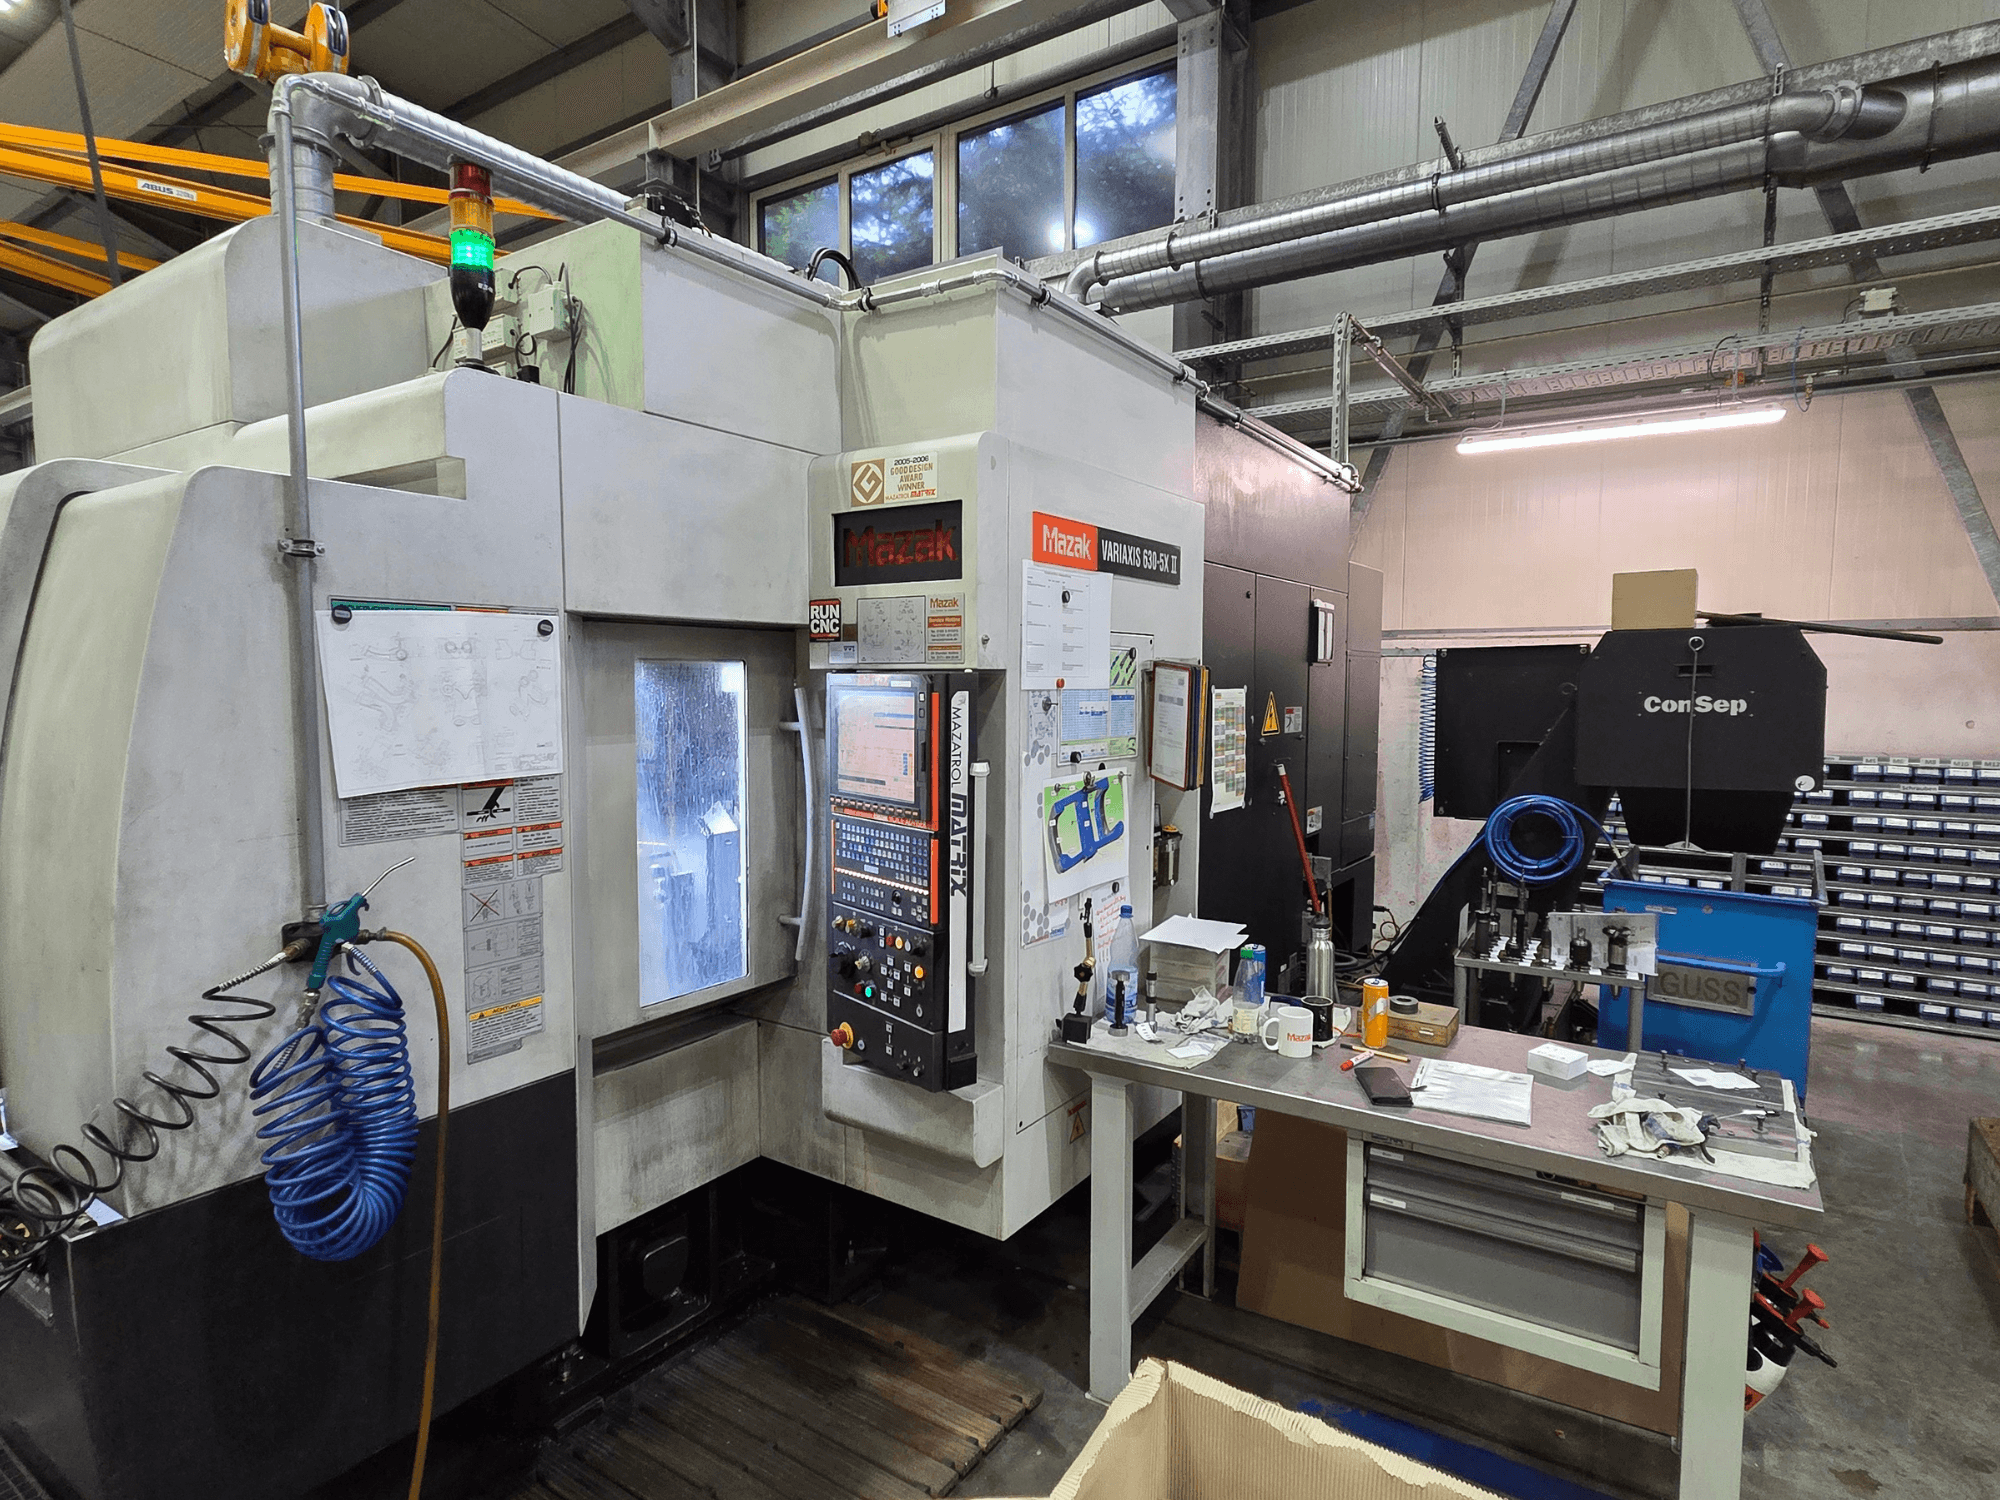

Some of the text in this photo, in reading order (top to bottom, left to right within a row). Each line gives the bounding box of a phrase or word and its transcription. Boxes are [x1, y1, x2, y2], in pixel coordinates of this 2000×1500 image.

[141, 182, 174, 195] ABUS
[894, 455, 929, 466] 2005-2006
[890, 462, 934, 476] GOOD DESIGN
[900, 472, 924, 483] AWARD
[897, 481, 925, 492] WINNER
[843, 519, 957, 568] Mazak
[1042, 523, 1092, 561] Mazak
[1101, 539, 1141, 568] VARIAXIS
[1142, 548, 1169, 573] 630-5X
[929, 597, 959, 609] Mazak
[810, 604, 840, 620] RUN
[810, 618, 840, 634] CNC
[1643, 695, 1748, 716] ConSep
[951, 706, 962, 788] MAZATROL
[1658, 970, 1741, 1005] GUSS
